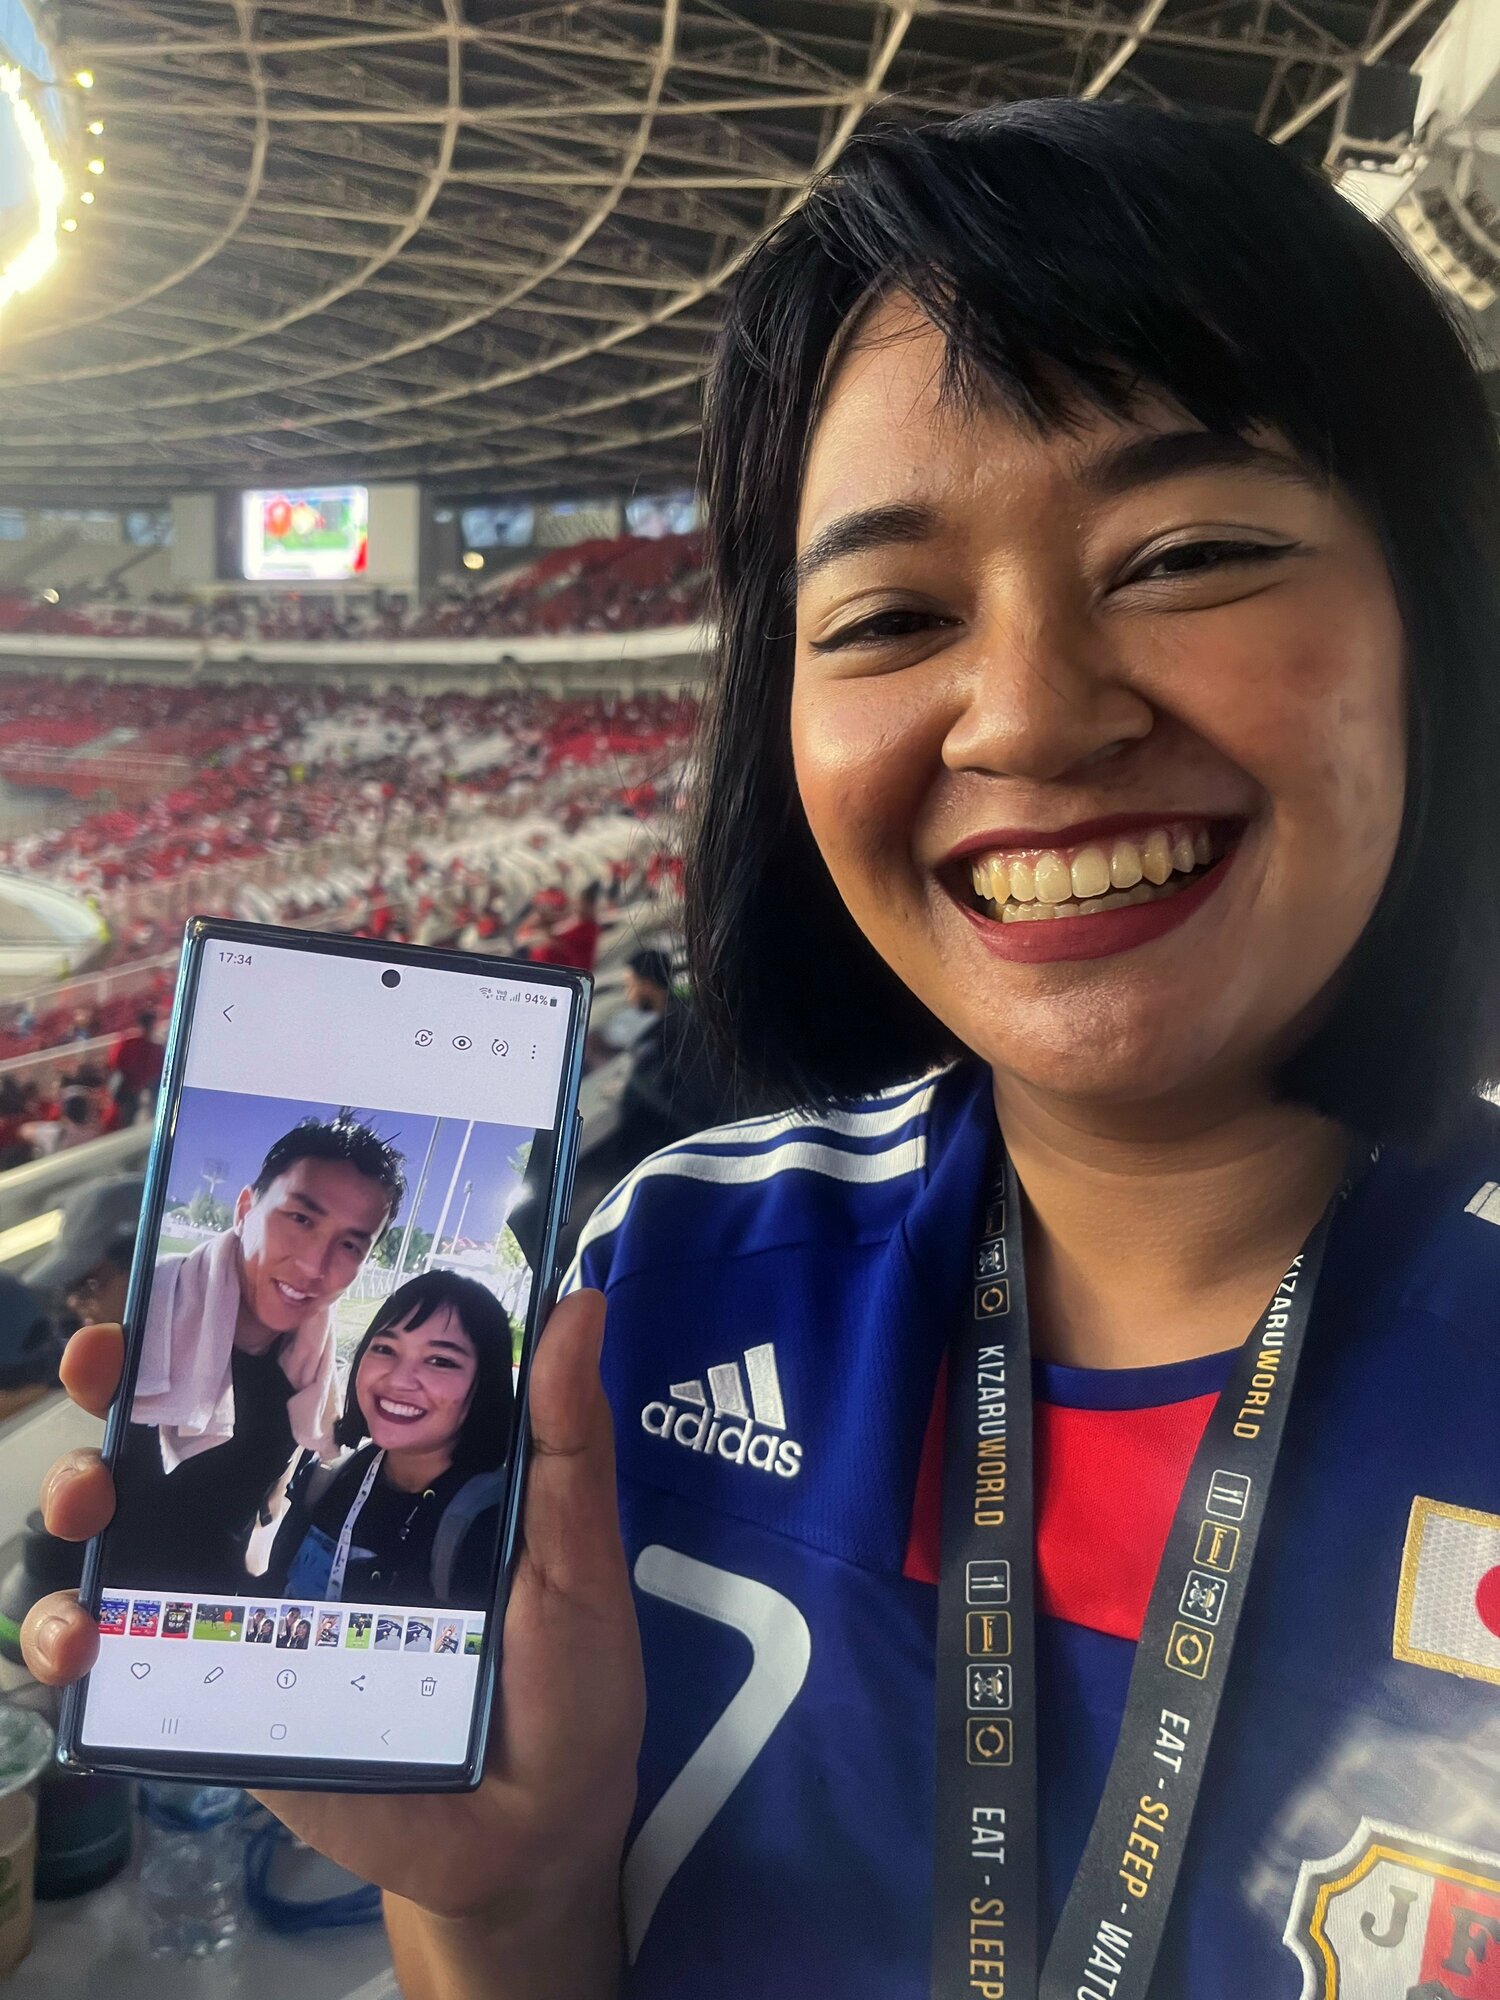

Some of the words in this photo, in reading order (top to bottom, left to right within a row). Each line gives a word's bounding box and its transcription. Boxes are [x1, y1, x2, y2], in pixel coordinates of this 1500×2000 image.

[218, 951, 252, 966] 17:34
[524, 993, 548, 1005] 94%
[640, 1400, 803, 1478] adidas
[973, 1343, 1006, 1527] KIZARUWORLD
[1152, 1708, 1190, 1773] EAT
[971, 1806, 1006, 1865] EAT
[1118, 1795, 1170, 1899] SLEEP
[969, 1896, 1005, 2000] SLEEP
